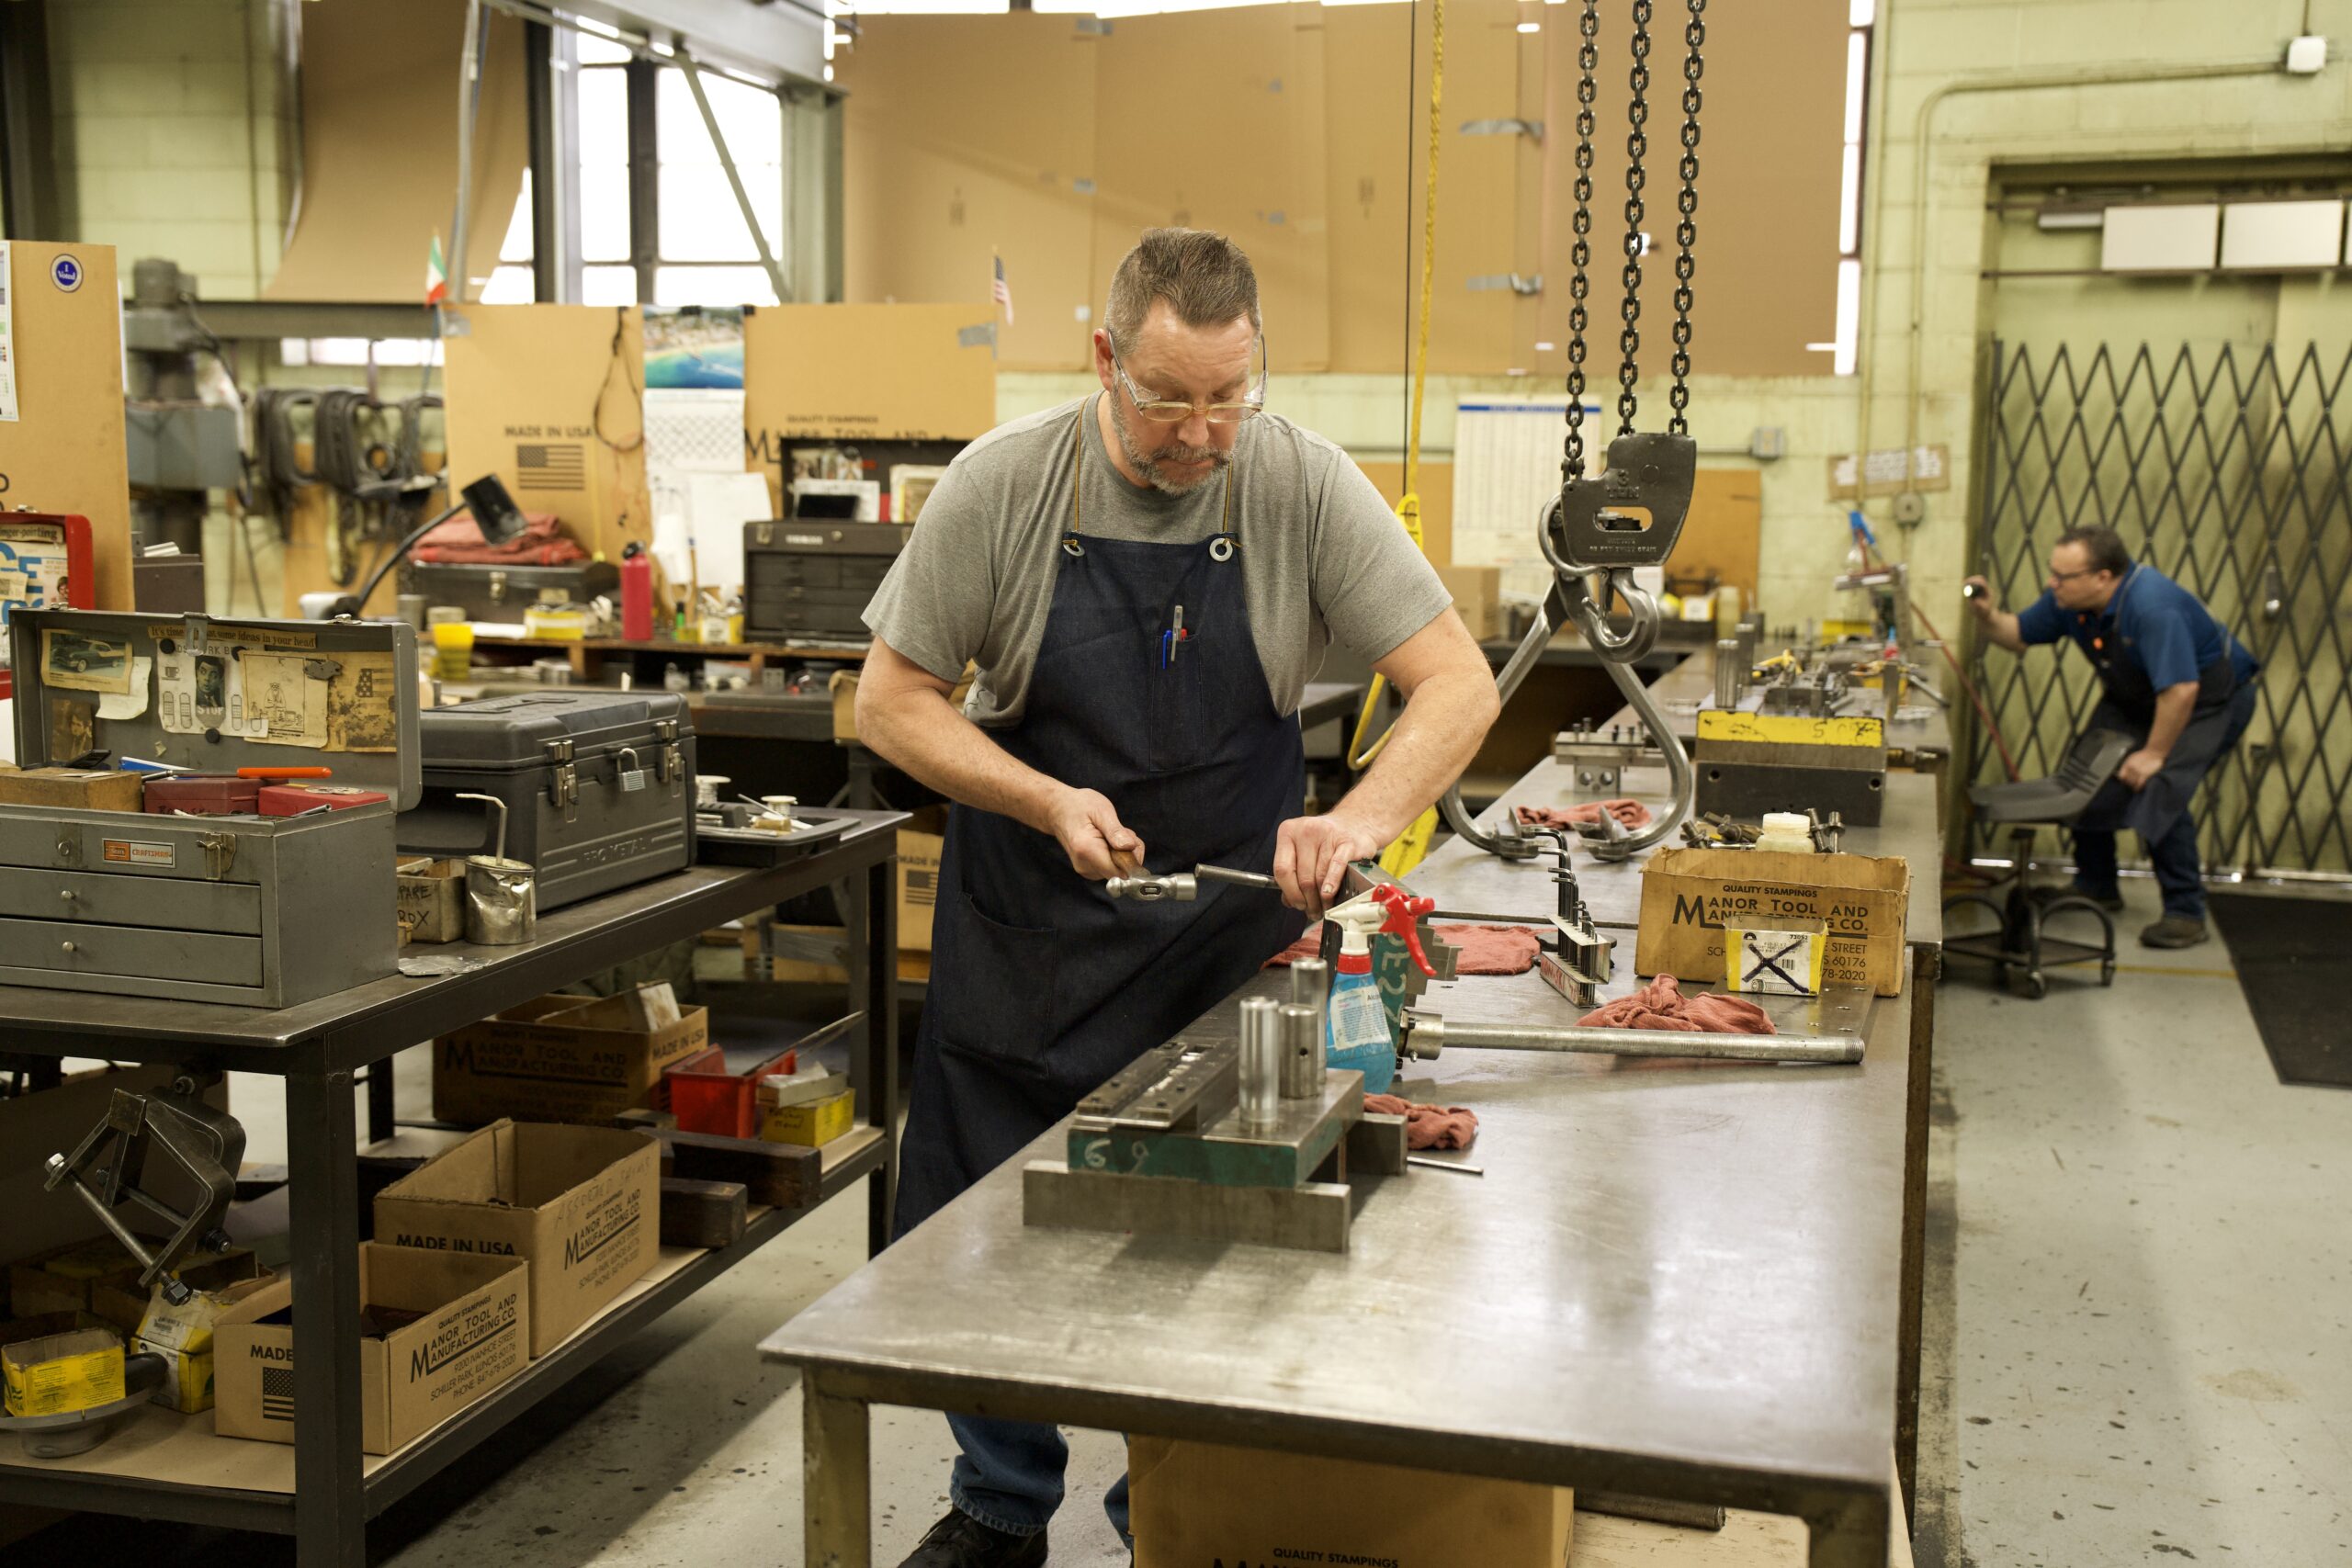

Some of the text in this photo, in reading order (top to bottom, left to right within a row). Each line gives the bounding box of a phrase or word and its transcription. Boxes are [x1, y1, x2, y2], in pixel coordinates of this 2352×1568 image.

[57, 270, 76, 281] Voted
[504, 425, 594, 438] MADE IN USA
[219, 631, 236, 640] some
[263, 633, 271, 642] in
[272, 636, 292, 646] your
[294, 636, 315, 648] head
[396, 884, 433, 902] PARE
[1723, 885, 1817, 897] QUALITY STAMPINGS
[1770, 899, 1817, 914] TOOL
[1830, 905, 1869, 918] AND
[1839, 919, 1869, 931] CO.
[1831, 943, 1867, 954] STREET
[1832, 955, 1867, 968] 60176
[1820, 969, 1866, 981] 78-2020
[652, 1028, 706, 1058] MADE IN USA
[537, 1044, 579, 1061] TOOL
[594, 1051, 627, 1065] AND
[605, 1204, 624, 1221] TOOL
[627, 1189, 641, 1204] AND
[396, 1235, 515, 1256] MADE IN USA
[438, 1294, 492, 1330] QUALITY STAMPINGS
[466, 1310, 492, 1330] TOOL
[497, 1293, 517, 1314] AND
[502, 1306, 517, 1322] CO.
[250, 1344, 294, 1361] MADE
[470, 1341, 497, 1363] IVANHOE
[497, 1328, 516, 1348] STREET
[430, 1379, 458, 1402] SCHILLER
[475, 1353, 498, 1373] ILLINOIS
[1273, 1547, 1398, 1568] QUALITY STAMPINGS
